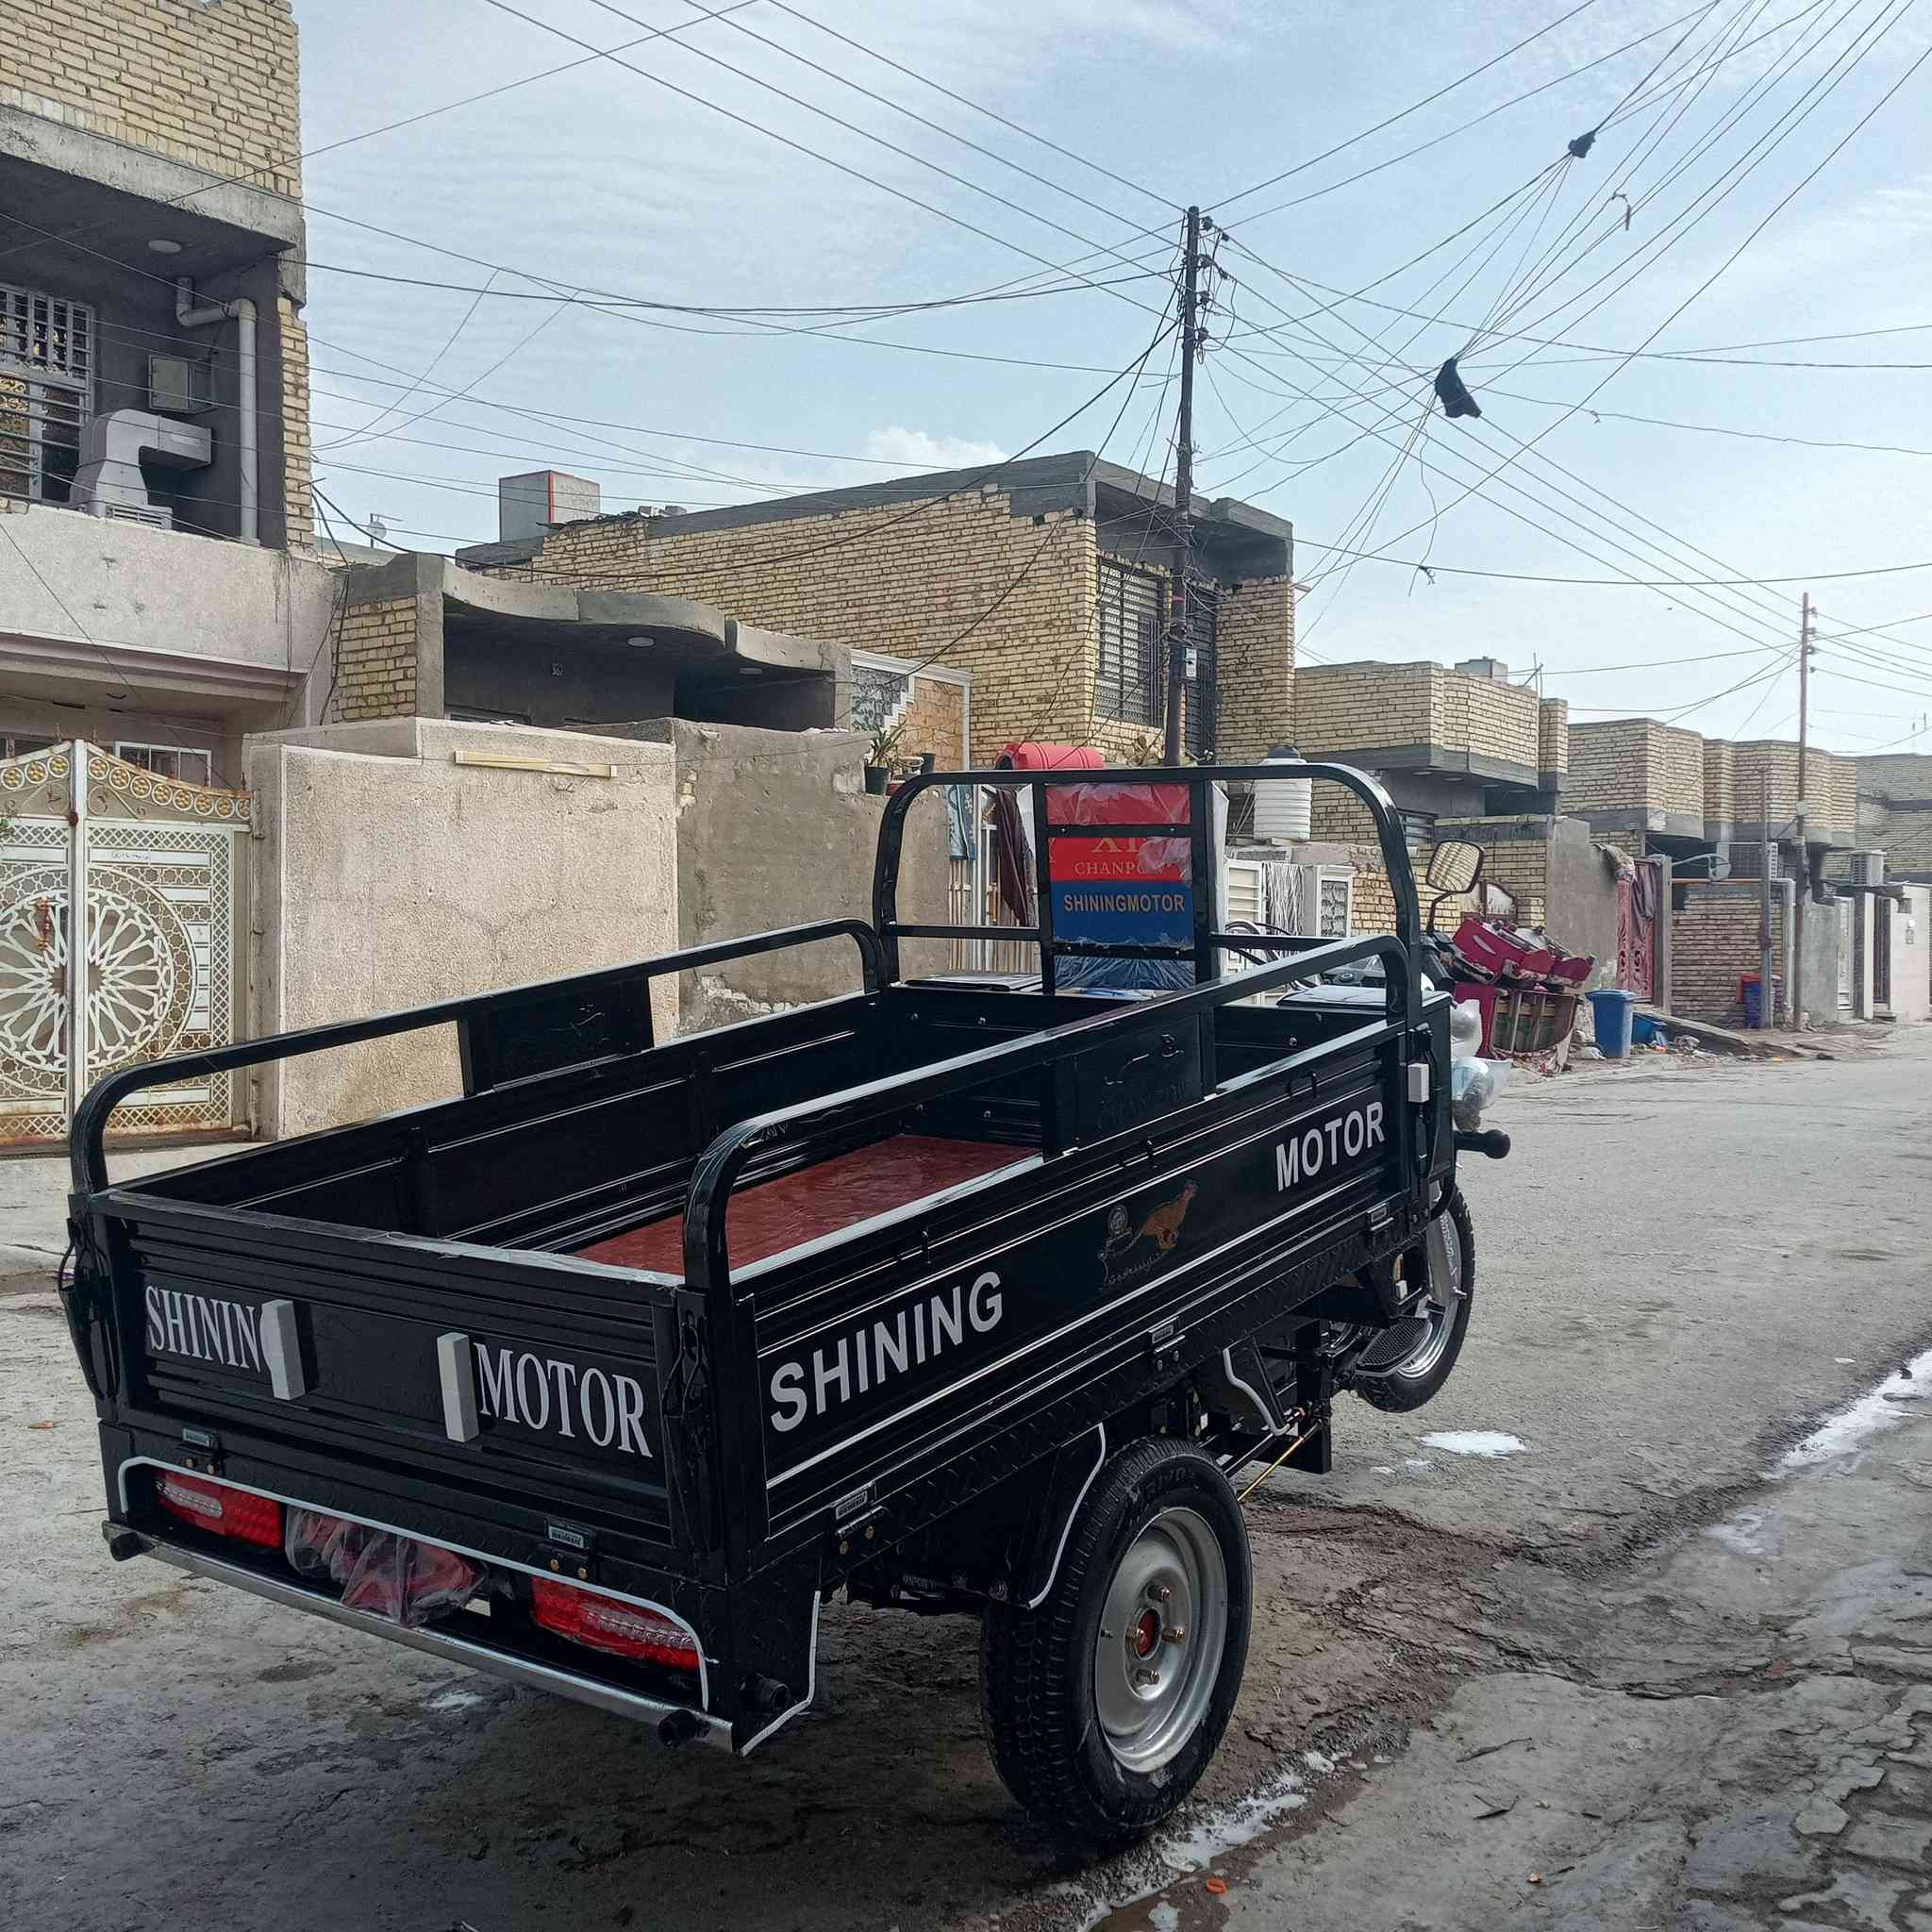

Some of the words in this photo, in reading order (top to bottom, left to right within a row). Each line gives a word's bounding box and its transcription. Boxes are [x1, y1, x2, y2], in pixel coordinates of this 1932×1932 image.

[1063, 894, 1186, 913] SHININGMOTOR
[769, 1270, 1004, 1433] SHINING
[1275, 1101, 1386, 1192] MOTOR
[145, 1285, 270, 1374] SHININ
[473, 1342, 654, 1457] MOTOR
